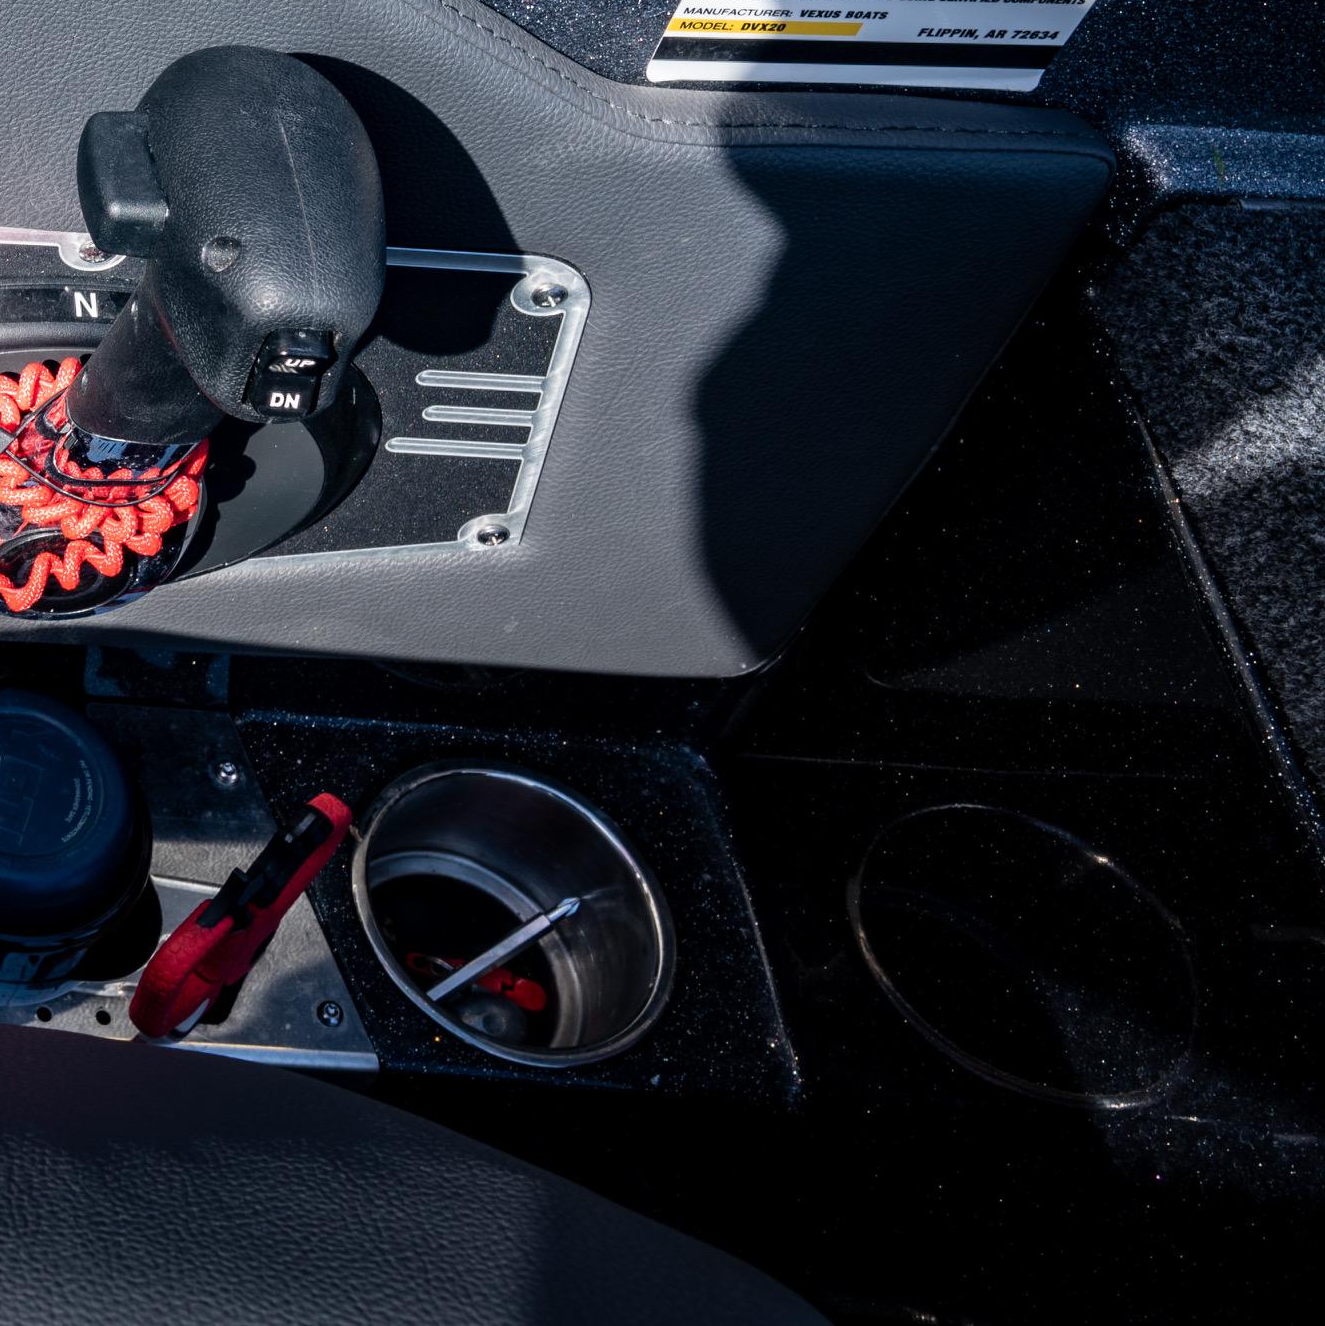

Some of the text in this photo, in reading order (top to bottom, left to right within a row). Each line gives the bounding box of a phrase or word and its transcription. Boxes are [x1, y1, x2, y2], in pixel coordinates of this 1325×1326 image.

[683, 7, 889, 20] MANUFACTURER: VEXUS BOATS
[679, 21, 787, 32] MODEL: DVX20
[917, 27, 1060, 40] FLIPPIN, AR 72634
[74, 291, 98, 318] N
[284, 358, 316, 367] UP
[269, 392, 301, 409] DN
